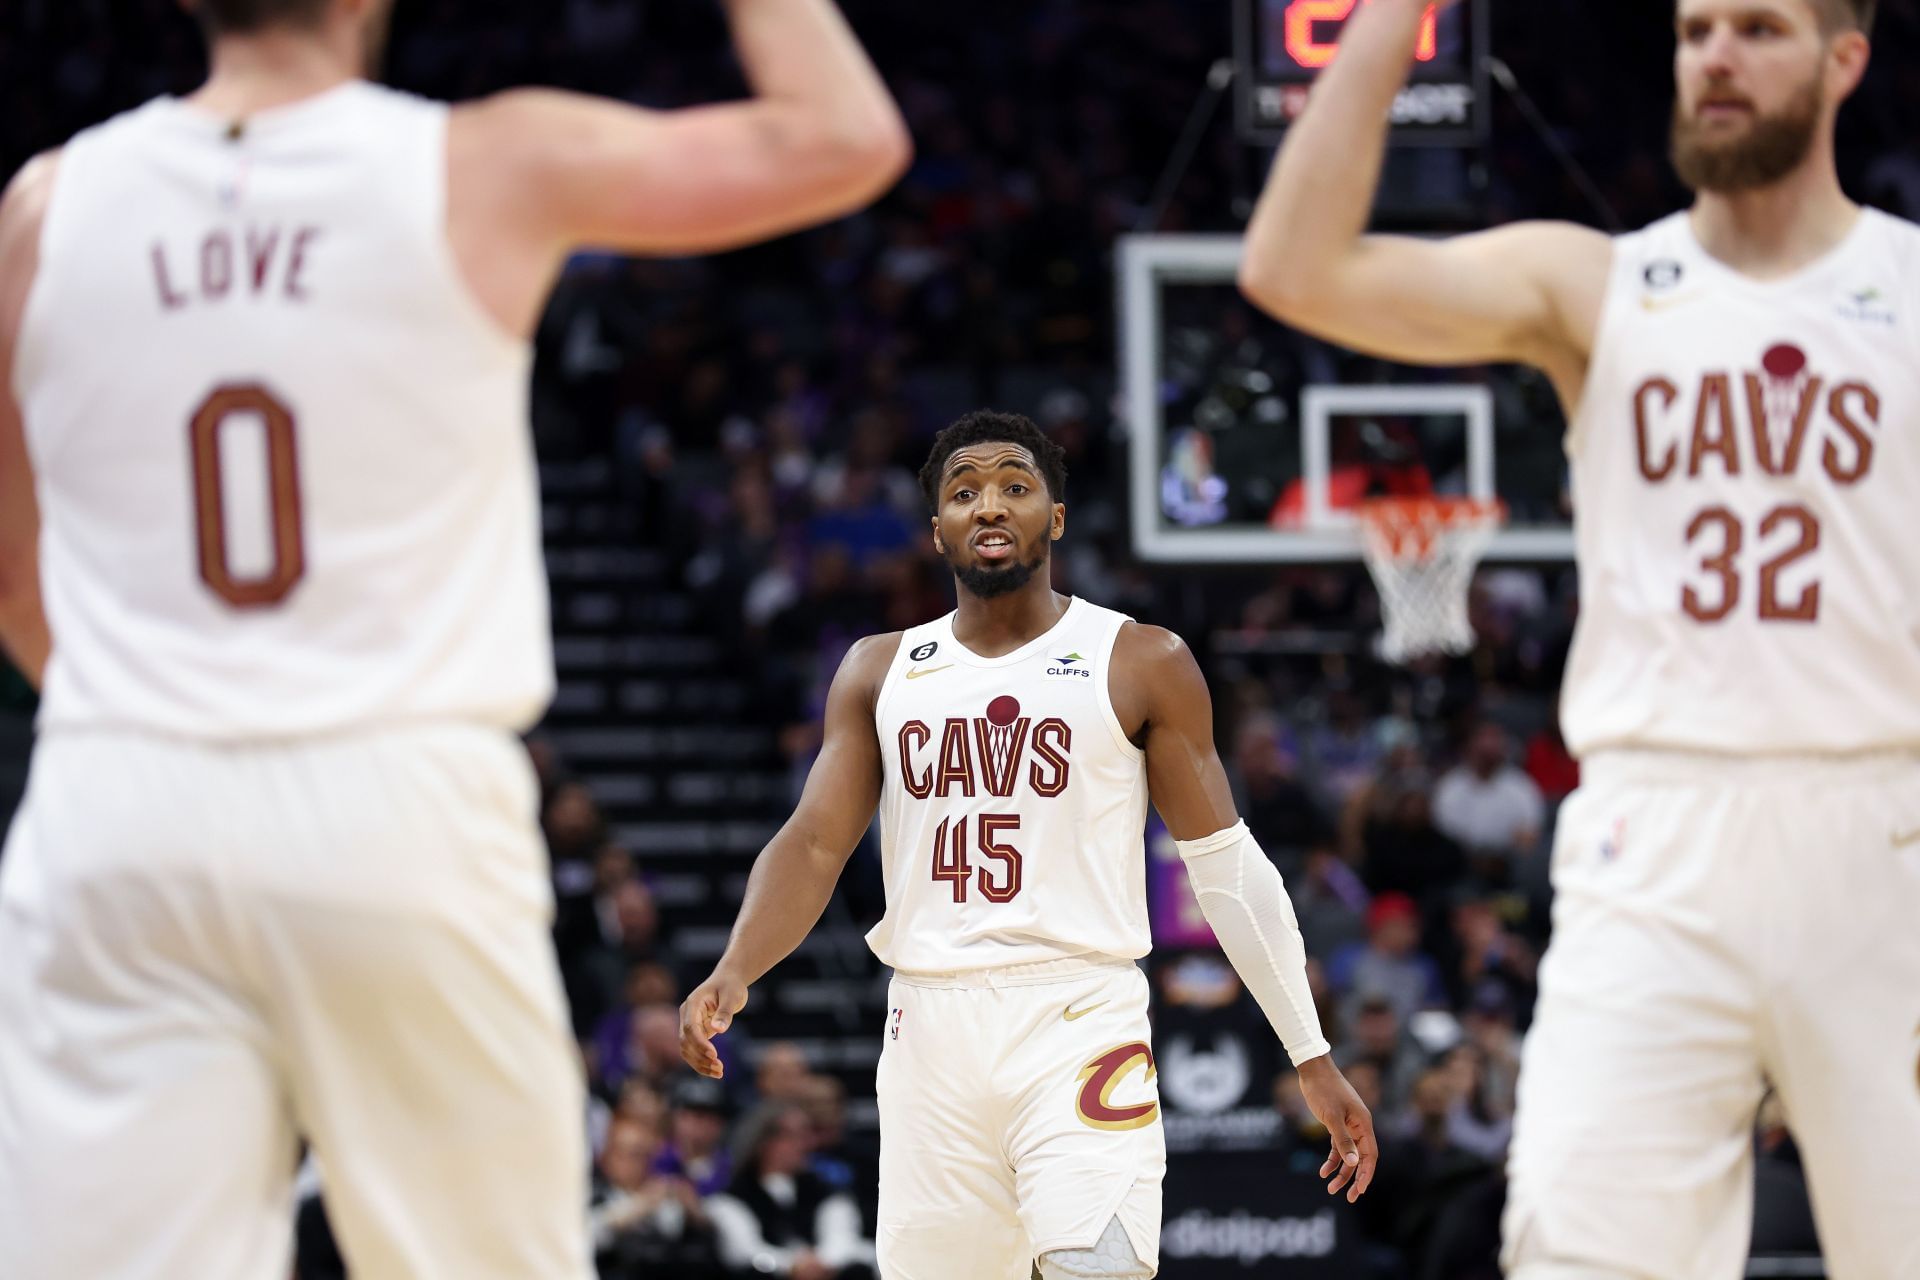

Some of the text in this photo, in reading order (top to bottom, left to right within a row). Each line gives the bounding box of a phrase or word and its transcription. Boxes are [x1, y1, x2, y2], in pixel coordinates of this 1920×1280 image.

[149, 221, 322, 308] LOVE
[1633, 371, 1879, 485] CAVS
[187, 379, 306, 613] 0
[1681, 504, 1821, 624] 32
[1046, 667, 1090, 677] CLIFFS
[898, 715, 1073, 800] CAVS
[931, 813, 1023, 904] 45
